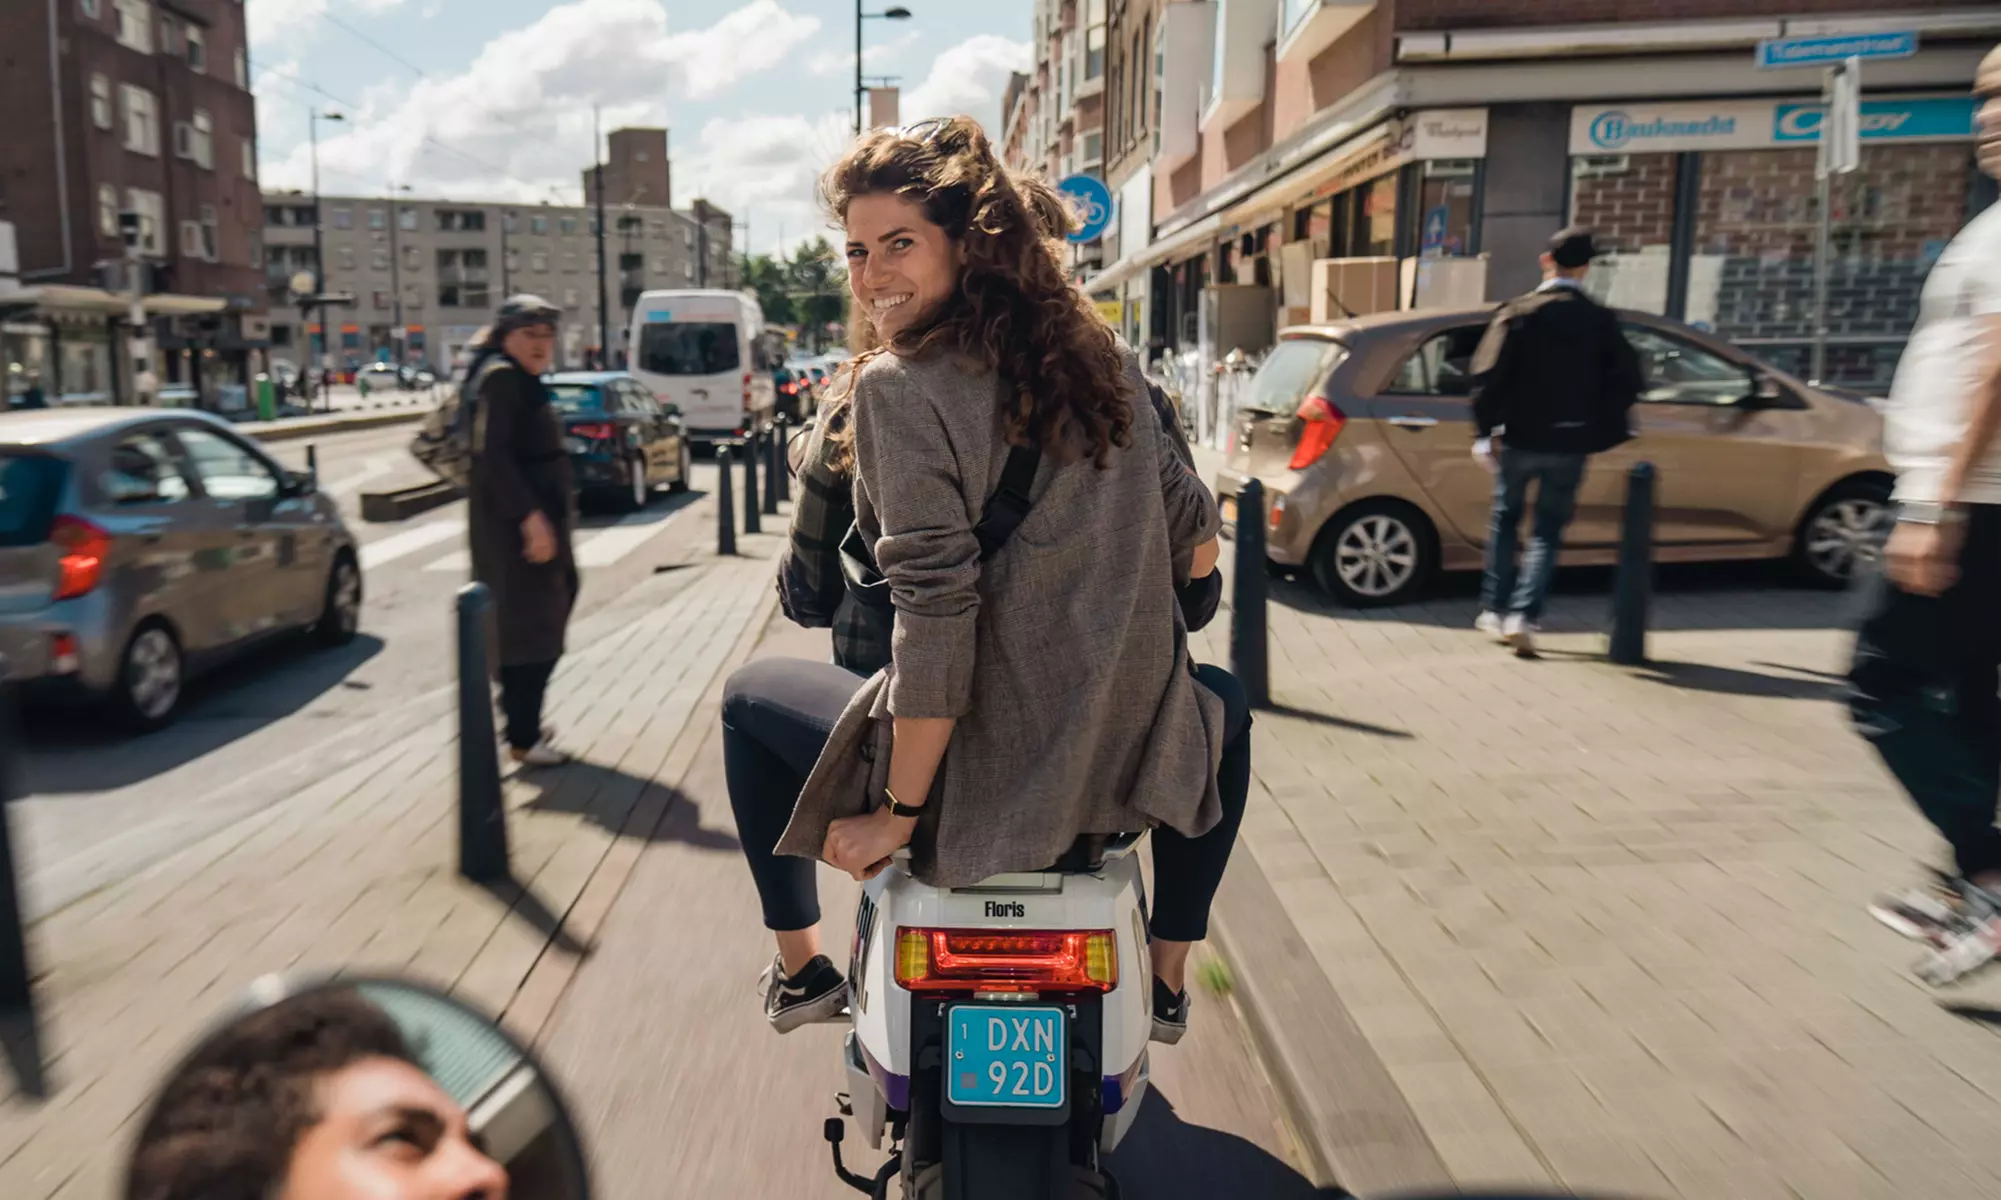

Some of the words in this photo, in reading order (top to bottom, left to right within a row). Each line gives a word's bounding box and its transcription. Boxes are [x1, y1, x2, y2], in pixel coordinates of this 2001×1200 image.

[984, 900, 1025, 918] Floris
[987, 1017, 1054, 1053] DXN
[987, 1060, 1054, 1096] 92D
